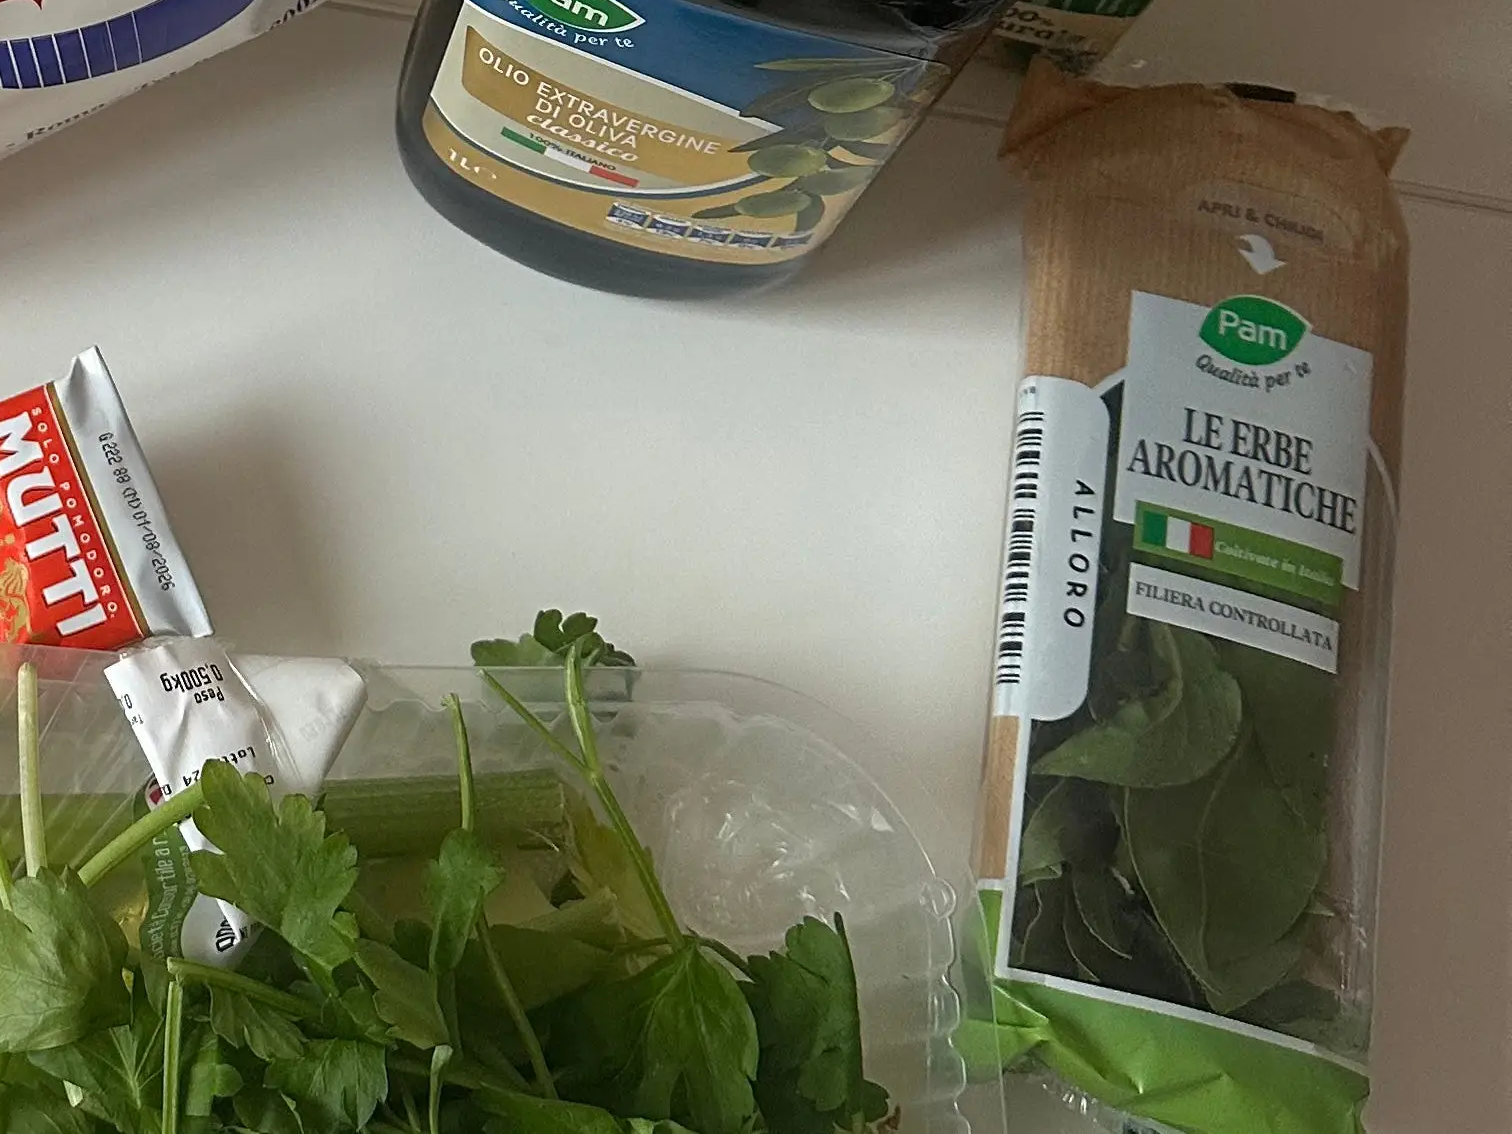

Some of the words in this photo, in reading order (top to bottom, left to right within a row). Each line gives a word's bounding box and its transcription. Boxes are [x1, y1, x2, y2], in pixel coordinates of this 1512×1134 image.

[573, 32, 608, 48] per
[615, 35, 635, 48] te
[478, 47, 530, 86] OLIO
[536, 81, 722, 155] EXTRAVERGINE
[535, 98, 561, 118] DI
[568, 113, 637, 149] OLIVA
[564, 149, 616, 171] ITALIANO
[1217, 308, 1287, 351] Pam
[1195, 354, 1259, 388] Qualità
[1264, 370, 1291, 393] per
[1294, 361, 1311, 378] te
[1183, 407, 1222, 448] LE
[1230, 418, 1314, 477] ERBE
[32, 407, 60, 464] SOLO
[59, 481, 117, 614] POMODORO
[1127, 437, 1358, 536] AROMATICHE
[132, 511, 176, 591] 01/08/2026
[1063, 479, 1096, 628] ALLORO
[1135, 581, 1205, 612] FILIERA
[1208, 601, 1333, 651] CONTROLLATA
[160, 663, 224, 693] 0,500kg
[194, 688, 226, 704] Peso
